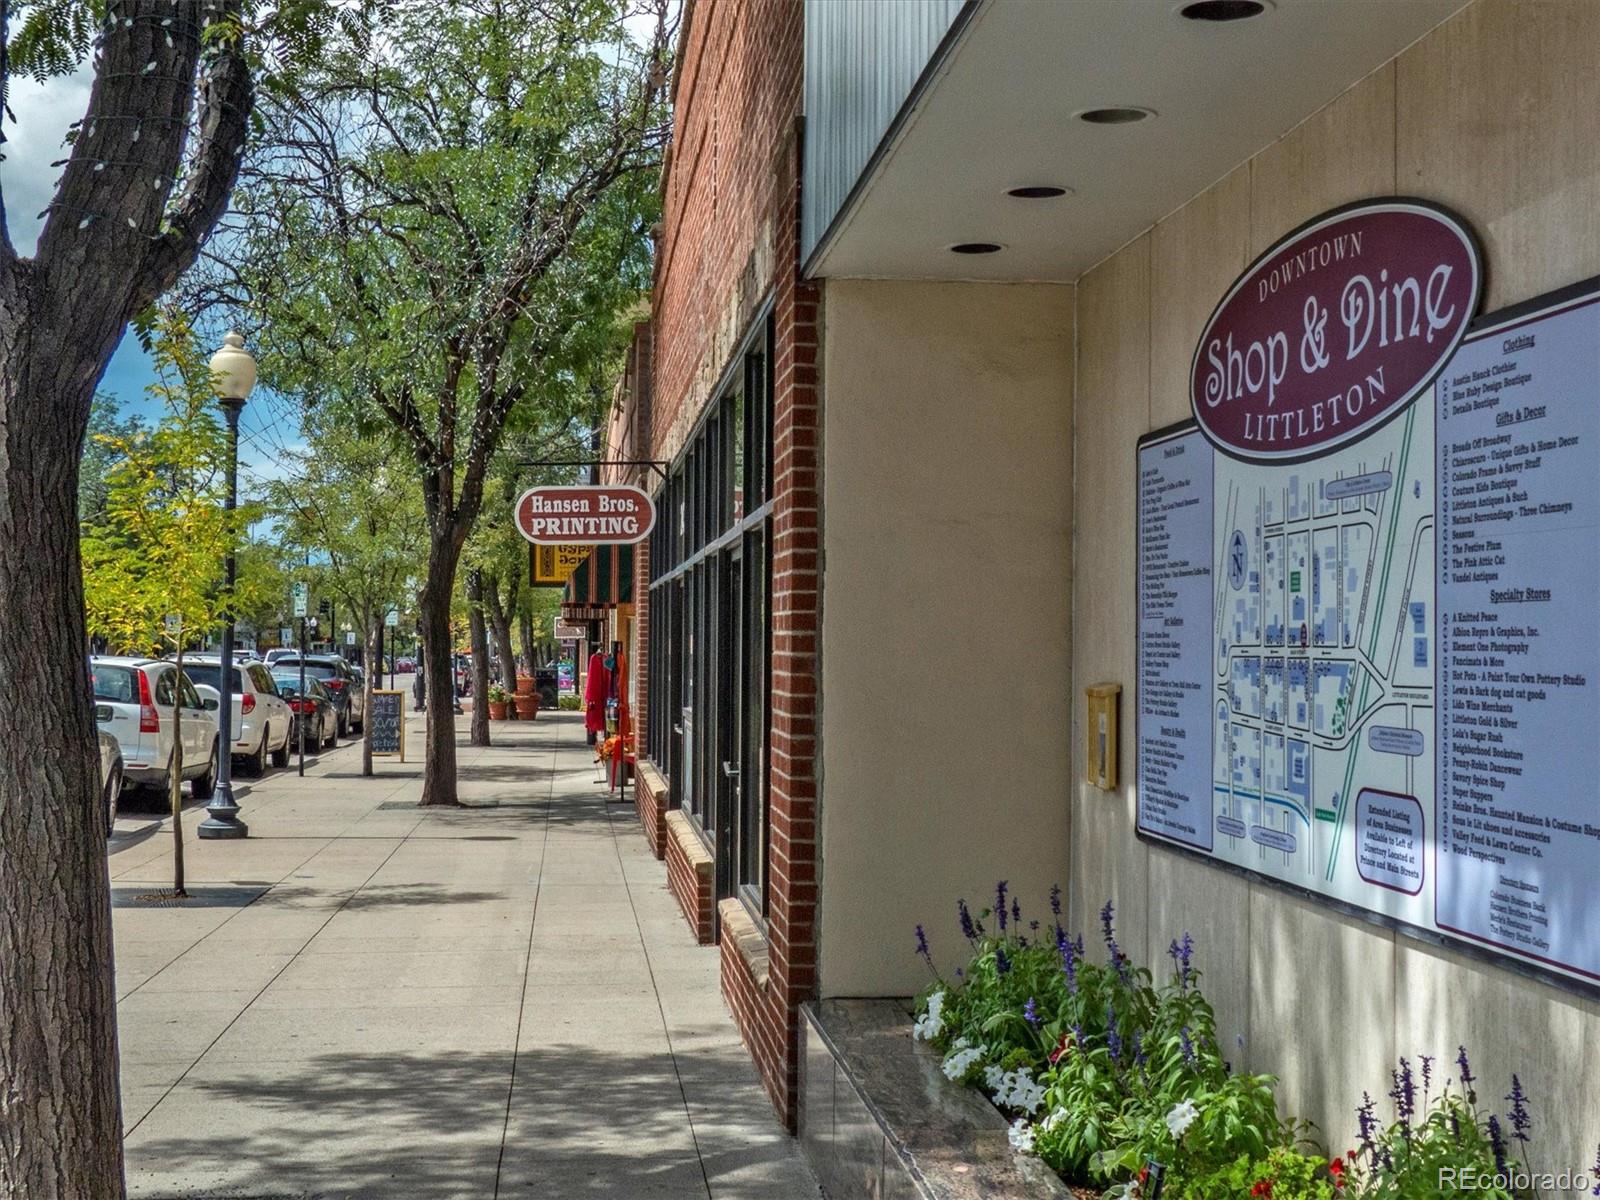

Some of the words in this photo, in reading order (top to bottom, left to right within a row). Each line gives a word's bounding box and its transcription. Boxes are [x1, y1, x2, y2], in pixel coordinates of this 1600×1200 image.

[1259, 231, 1362, 302] DOWNTOWN
[1206, 331, 1288, 407] Shop
[1300, 296, 1330, 374] &
[1341, 264, 1455, 360] Dine
[1503, 335, 1535, 353] Clothing
[1467, 386, 1481, 398] Ruby
[1504, 373, 1532, 387] Boutique
[1244, 366, 1386, 441] LITTLETON
[1452, 402, 1472, 415] Details
[1474, 397, 1499, 409] Boutique
[1496, 412, 1513, 425] Gifts
[1516, 410, 1522, 420] &
[1524, 406, 1546, 419] Decor
[1473, 437, 1481, 449] Off
[1483, 434, 1512, 448] Broadway
[1491, 448, 1512, 461] Unique
[1514, 445, 1529, 455] Gifts
[1531, 443, 1536, 453] &
[1537, 440, 1556, 451] Home
[1559, 436, 1579, 447] Decor
[1452, 471, 1477, 482] Colorado
[1479, 467, 1496, 478] Frame
[1499, 465, 1503, 474] &
[1525, 457, 1541, 469] Stuff
[1476, 482, 1489, 492] Kids
[1491, 478, 1517, 490] Boutique
[532, 496, 590, 513] Hansen
[599, 495, 639, 512] Bros.
[1452, 499, 1476, 511] Littleton
[1478, 496, 1504, 508] Antiques
[1506, 494, 1511, 503] &
[1512, 491, 1528, 502] Such
[1452, 514, 1472, 525] Natural
[1474, 510, 1514, 522] Surroundings
[1519, 506, 1537, 516] Three
[1539, 502, 1572, 514] Chimneys
[532, 517, 639, 535] PRINTING
[1452, 544, 1463, 554] The
[1464, 543, 1484, 552] Festive
[1486, 541, 1502, 550] Plum
[1452, 559, 1463, 568] The
[1464, 559, 1477, 567] Pink
[1479, 557, 1493, 566] Attic
[1495, 556, 1506, 565] Cat
[1473, 572, 1498, 583] Antiques
[1490, 589, 1524, 603] Specialty
[1526, 589, 1551, 599] Stores
[1453, 613, 1457, 622] A
[1458, 612, 1479, 622] Knitted
[1481, 613, 1497, 621] Peace
[1491, 627, 1495, 636] &
[1527, 626, 1540, 636] Inc.
[1453, 642, 1475, 651] Element
[1477, 643, 1488, 651] One
[1491, 642, 1529, 654] Photography
[1483, 657, 1488, 666] &
[1490, 657, 1504, 667] More
[1452, 671, 1463, 680] Hot
[1464, 671, 1476, 681] Pots
[1482, 672, 1486, 681] A
[1488, 672, 1503, 682] Paint
[1505, 672, 1519, 683] Your
[1521, 673, 1535, 683] Own
[1537, 674, 1561, 687] Pottery
[1563, 674, 1585, 686] Studio
[1476, 686, 1489, 696] Bark
[1491, 687, 1501, 700] dog
[1503, 688, 1514, 698] and
[1516, 690, 1526, 698] cat
[1527, 689, 1546, 701] goods
[1466, 700, 1480, 710] Wine
[1482, 701, 1513, 713] Merchants
[1453, 715, 1477, 725] Littleton
[1479, 717, 1492, 726] Gold
[1500, 718, 1518, 728] Silver
[1470, 731, 1486, 742] Sugar
[1453, 743, 1491, 756] Neighborhood
[1493, 748, 1523, 760] Bookstore
[1490, 762, 1522, 776] Dancewear
[1473, 775, 1488, 787] Spice
[1490, 777, 1505, 791] Shop
[1452, 787, 1468, 799] Super
[1368, 805, 1391, 817] Extended
[1392, 808, 1410, 824] Listing
[1490, 807, 1515, 821] Haunted
[1517, 812, 1543, 827] Mansion
[1552, 819, 1582, 834] Costume
[1367, 831, 1388, 843] Available
[1389, 837, 1395, 845] to
[1396, 837, 1406, 848] Left
[1407, 840, 1413, 849] of
[1452, 829, 1470, 842] Valley
[1471, 833, 1485, 846] Feed
[1492, 838, 1508, 850] Lawn
[1509, 842, 1531, 854] Center
[1484, 823, 1500, 833] shoes
[1502, 825, 1513, 836] and
[1515, 830, 1550, 844] accessories
[1364, 843, 1387, 858] Directory
[1388, 848, 1408, 862] Located
[1452, 844, 1467, 855] Wood
[1469, 848, 1505, 864] Perspectives
[1377, 860, 1385, 870] and
[1387, 861, 1399, 873] Main
[1400, 865, 1419, 878] Streets
